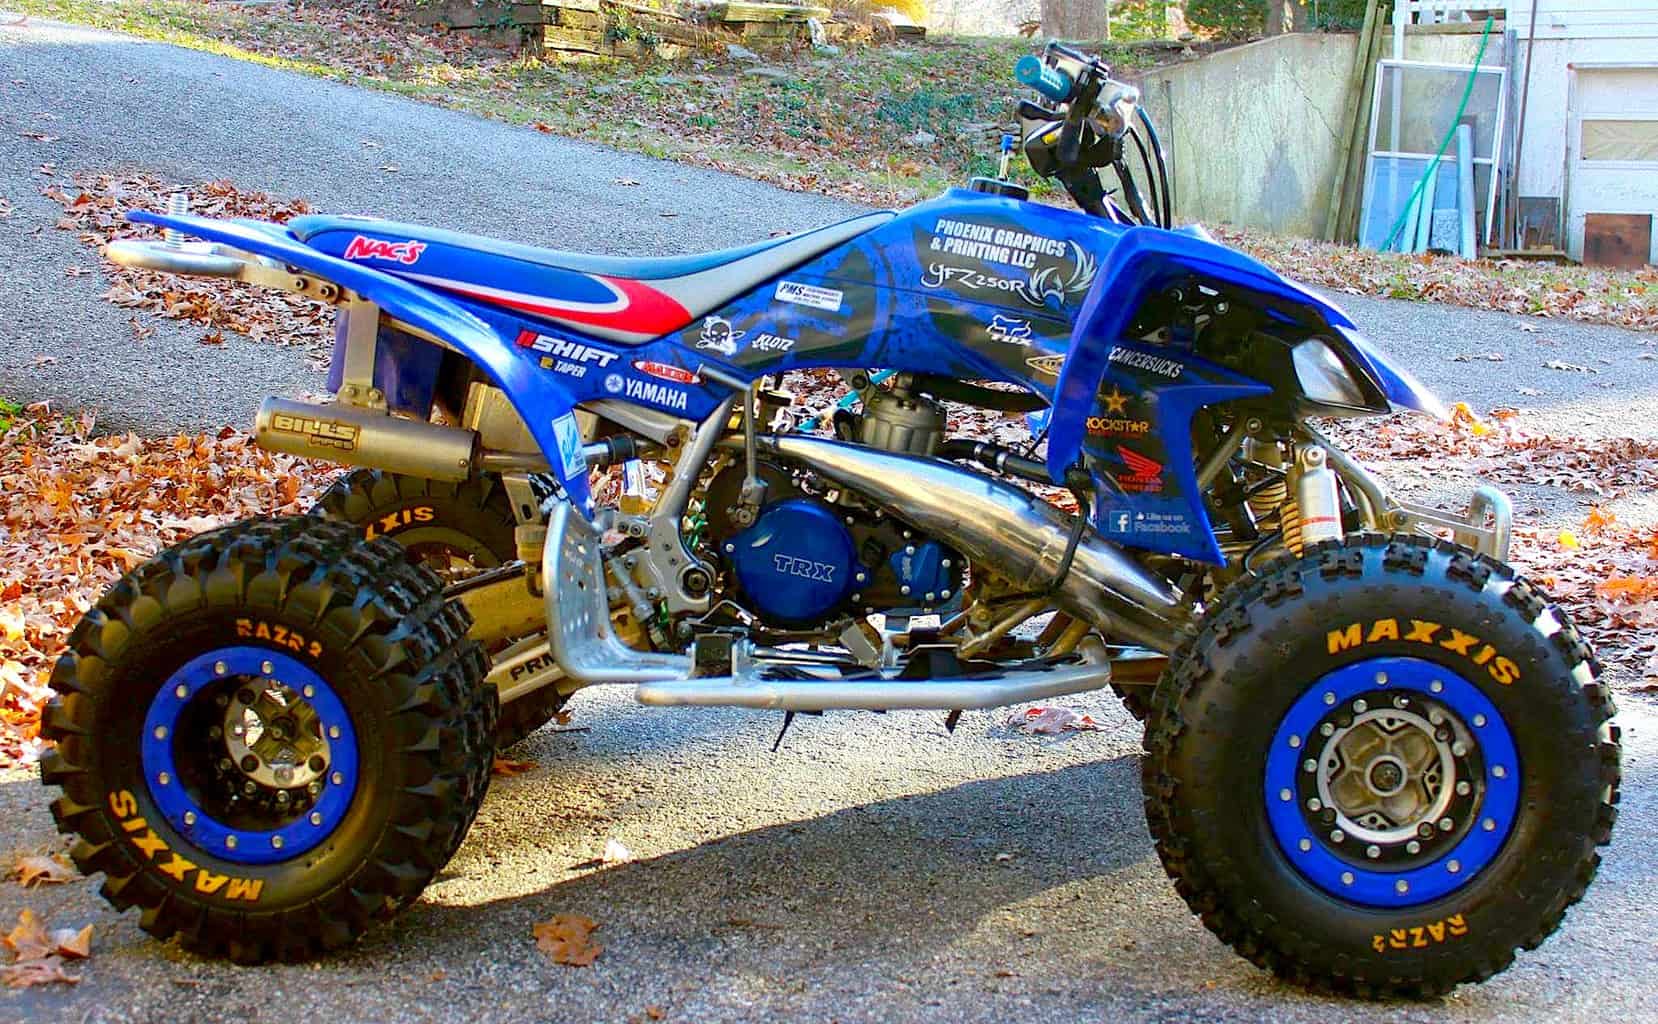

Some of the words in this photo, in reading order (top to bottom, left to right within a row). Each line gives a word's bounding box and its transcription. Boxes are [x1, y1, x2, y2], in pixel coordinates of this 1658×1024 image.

[930, 237, 942, 250] &
[943, 238, 1009, 264] PRINTING
[1012, 253, 1038, 268] LLC
[934, 219, 994, 243] PHOENIX
[994, 229, 1067, 257] GRAPHICS
[780, 283, 805, 296] PMS
[532, 334, 619, 368] SHIFT
[753, 334, 795, 350] KLOTZ
[554, 360, 587, 378] TAPER
[624, 377, 688, 410] YAMAHA
[773, 553, 836, 583] TRX
[1327, 618, 1521, 685] MAXXIS
[109, 789, 264, 900] MAXXIS
